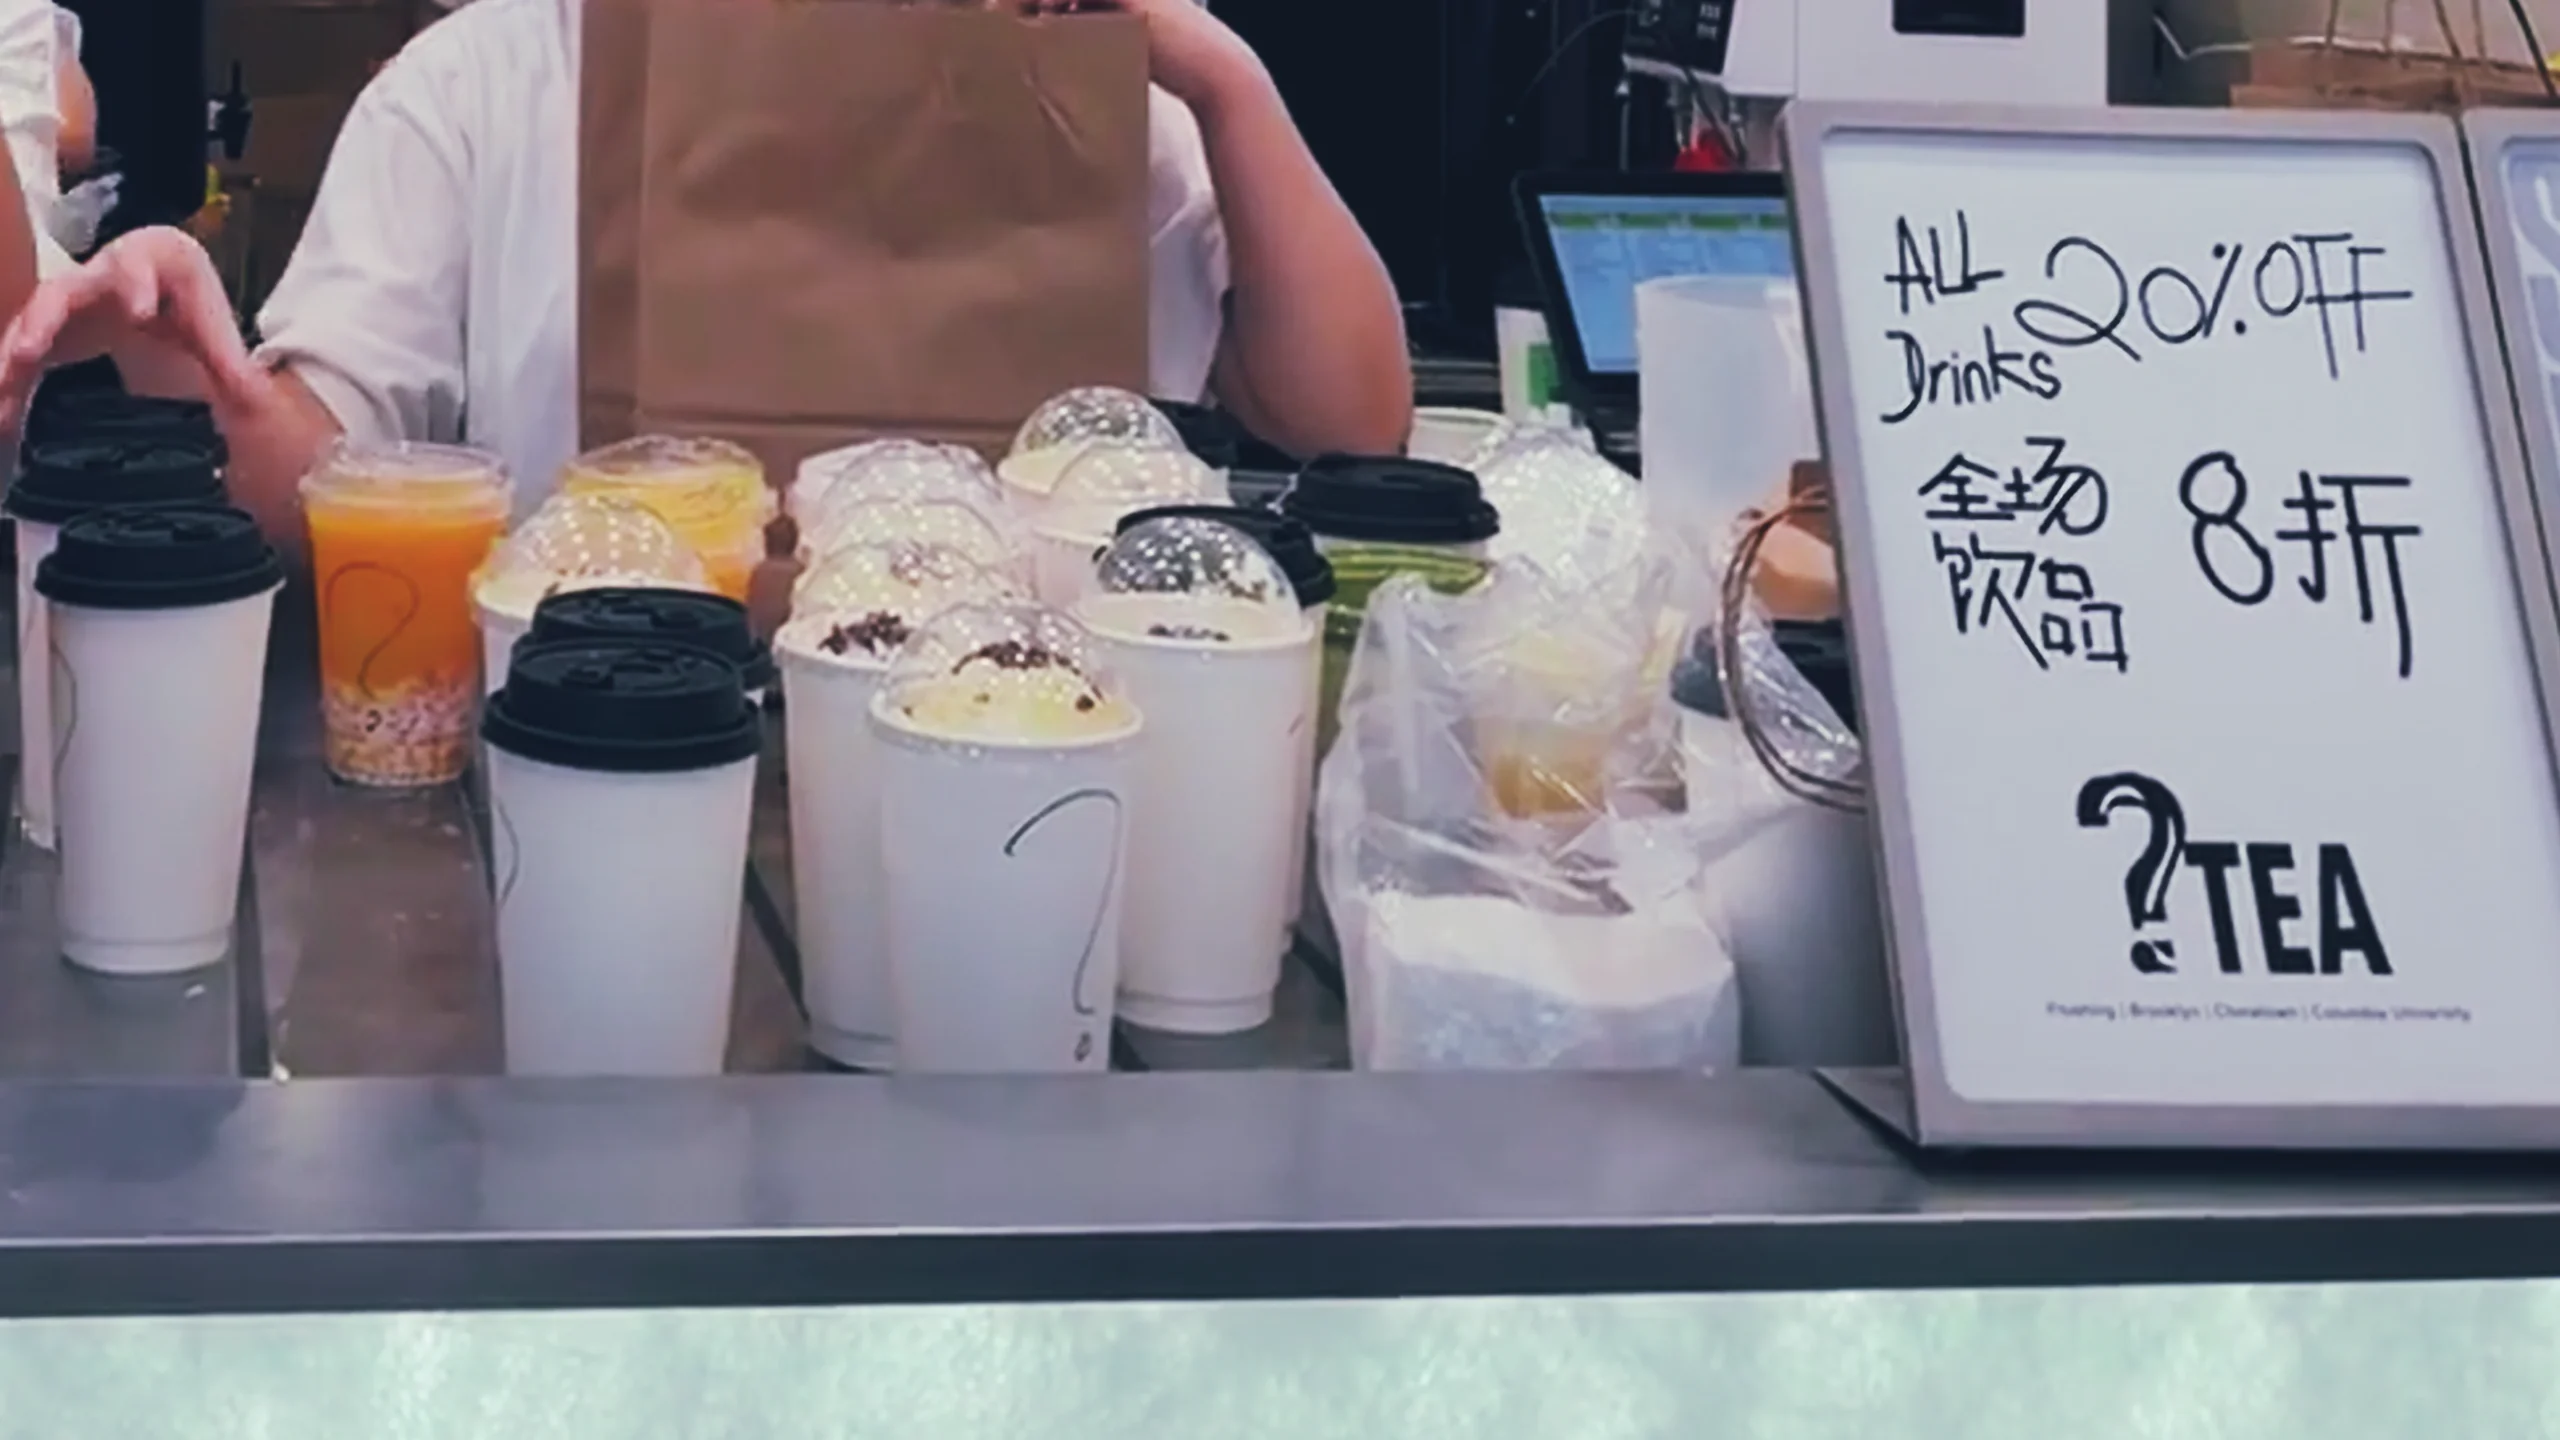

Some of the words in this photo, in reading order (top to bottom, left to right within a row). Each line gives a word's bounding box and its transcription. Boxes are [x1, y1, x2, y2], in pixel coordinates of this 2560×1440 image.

[1883, 209, 2005, 315] ALL
[2012, 235, 2248, 363] 20%
[2253, 231, 2414, 379] OFF
[1879, 324, 2063, 425] Drinks
[1916, 435, 2109, 537] 全场
[1931, 530, 2130, 675] 饮品
[2177, 450, 2423, 680] 8折
